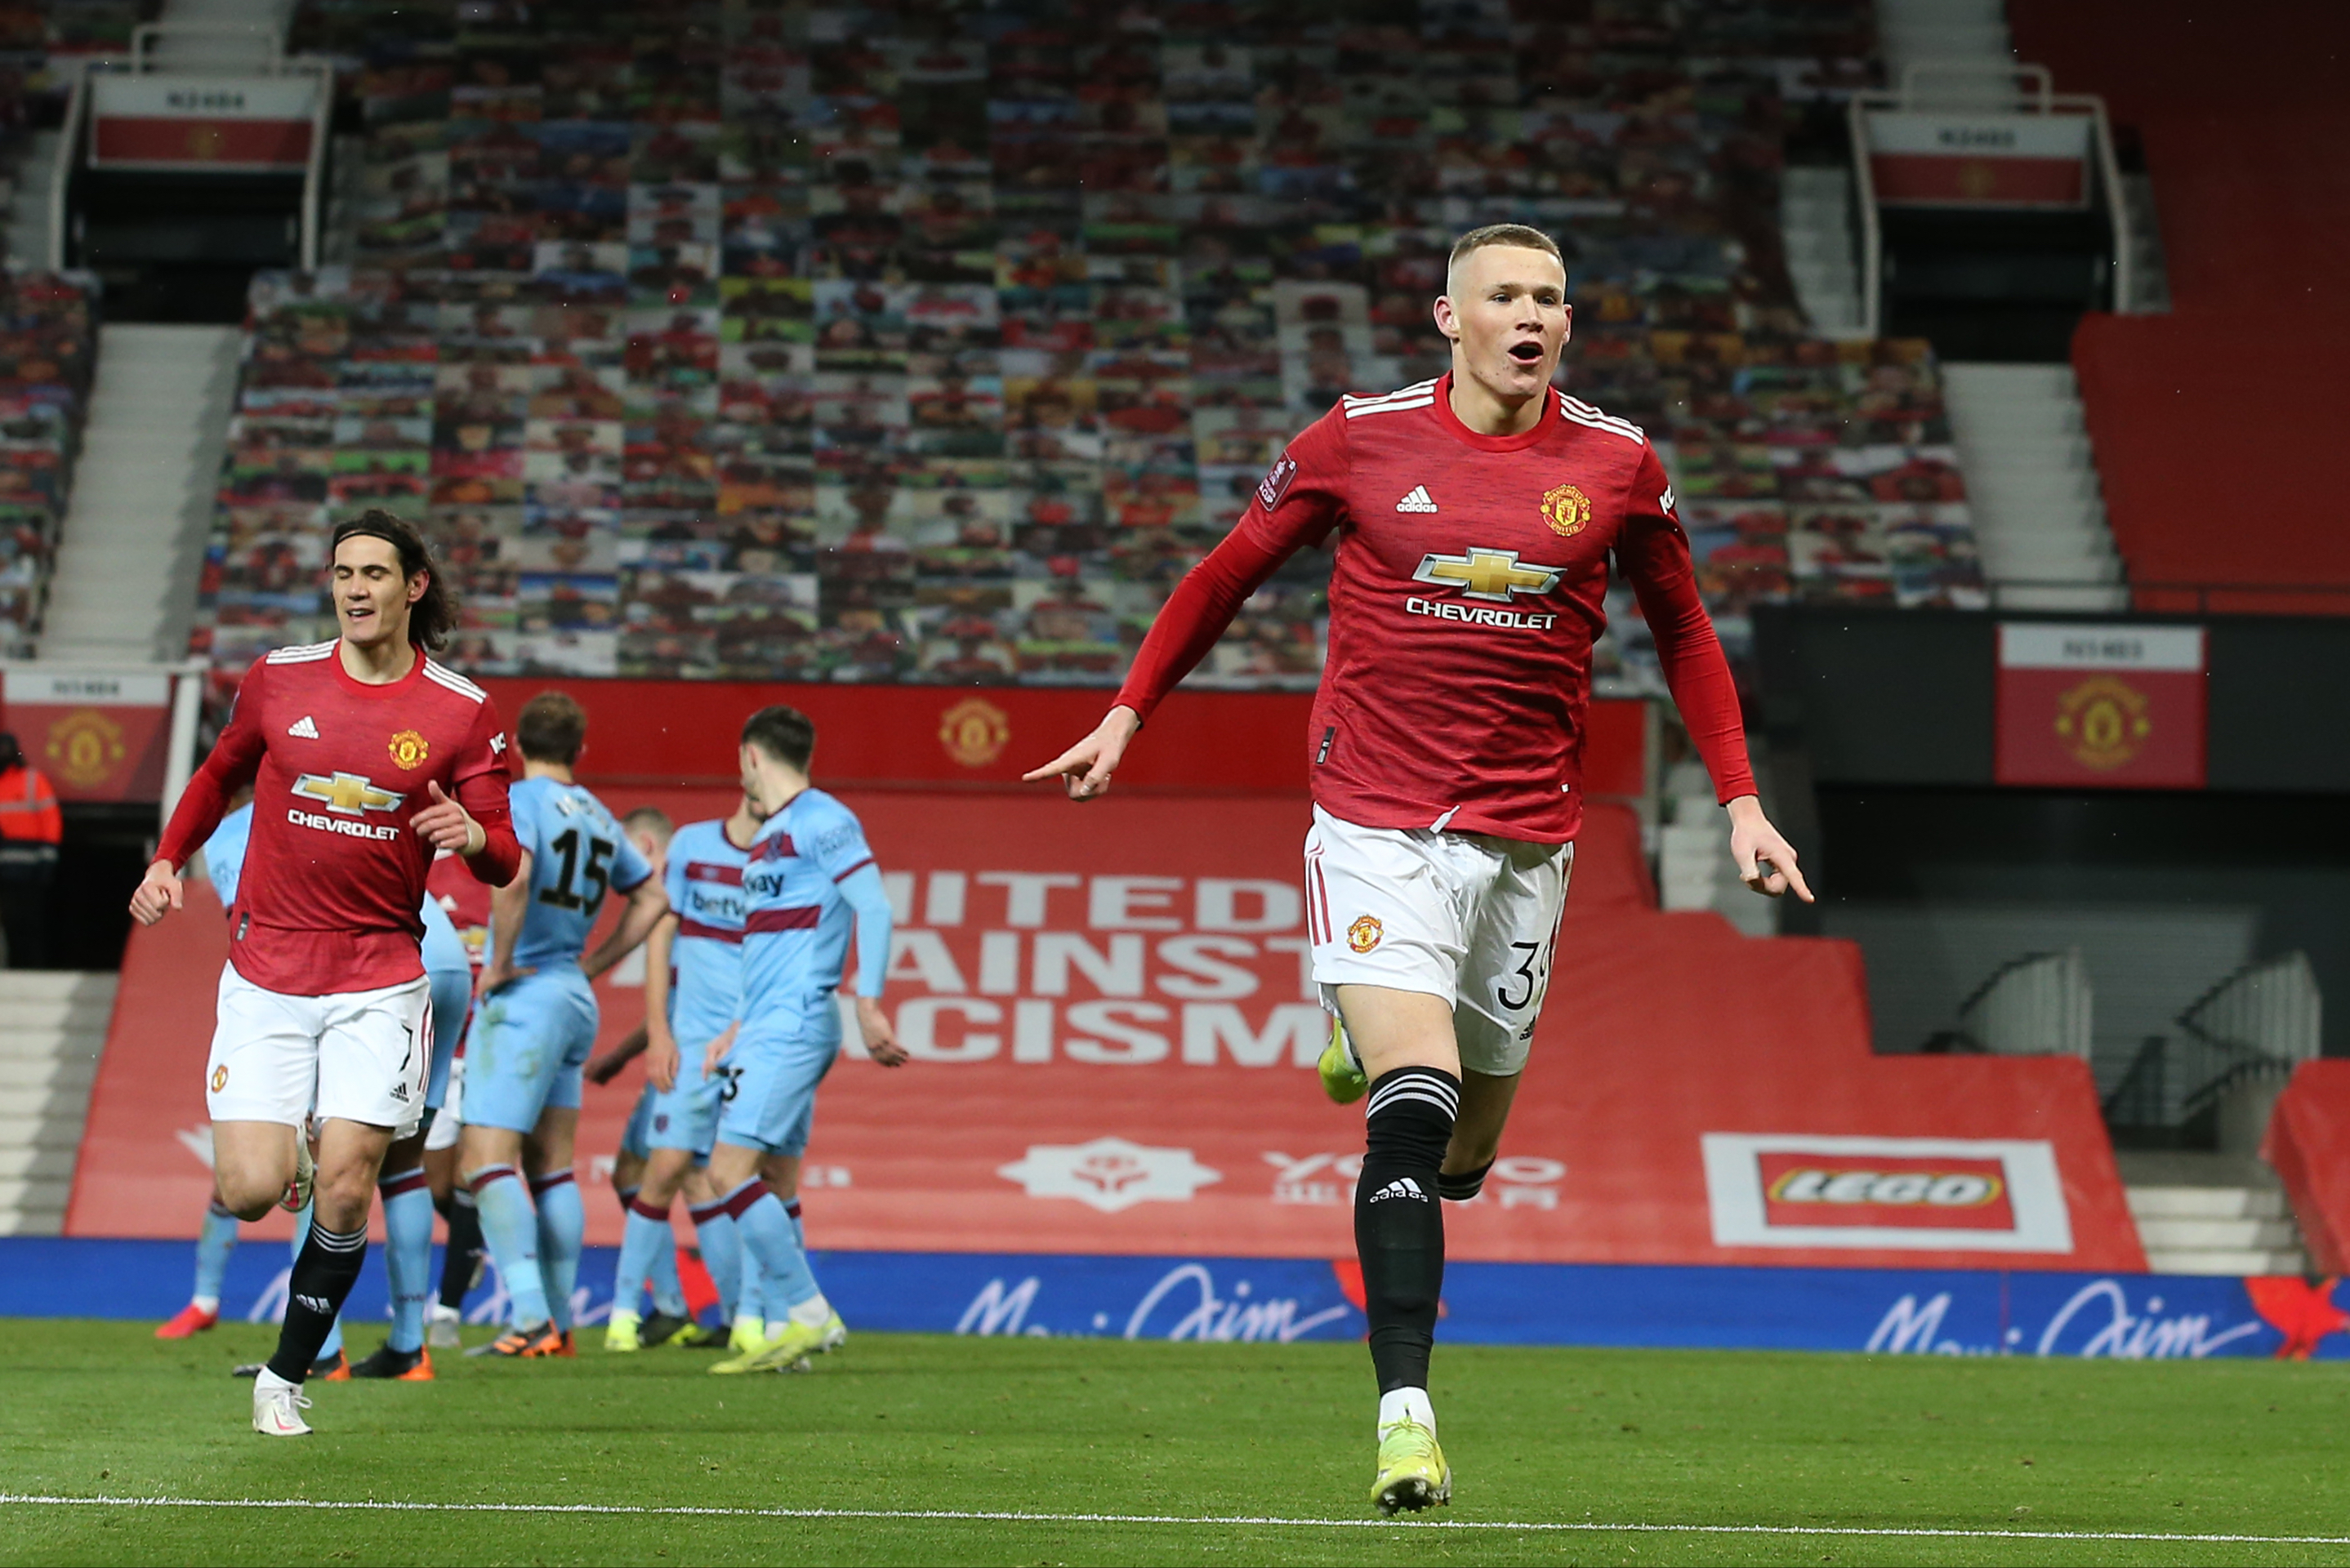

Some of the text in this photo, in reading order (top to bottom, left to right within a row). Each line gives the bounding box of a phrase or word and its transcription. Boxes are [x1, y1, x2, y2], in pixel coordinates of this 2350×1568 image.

[1396, 502, 1438, 513] adidas
[1406, 596, 1558, 630] CHEVROLET
[288, 808, 399, 840] CHEVROLET
[538, 828, 614, 917] 15
[884, 871, 1302, 933] ITED
[399, 1023, 413, 1072] 7
[835, 995, 1328, 1067] CISM
[1369, 1190, 1429, 1203] adidas
[1781, 1169, 1991, 1205] LEGO
